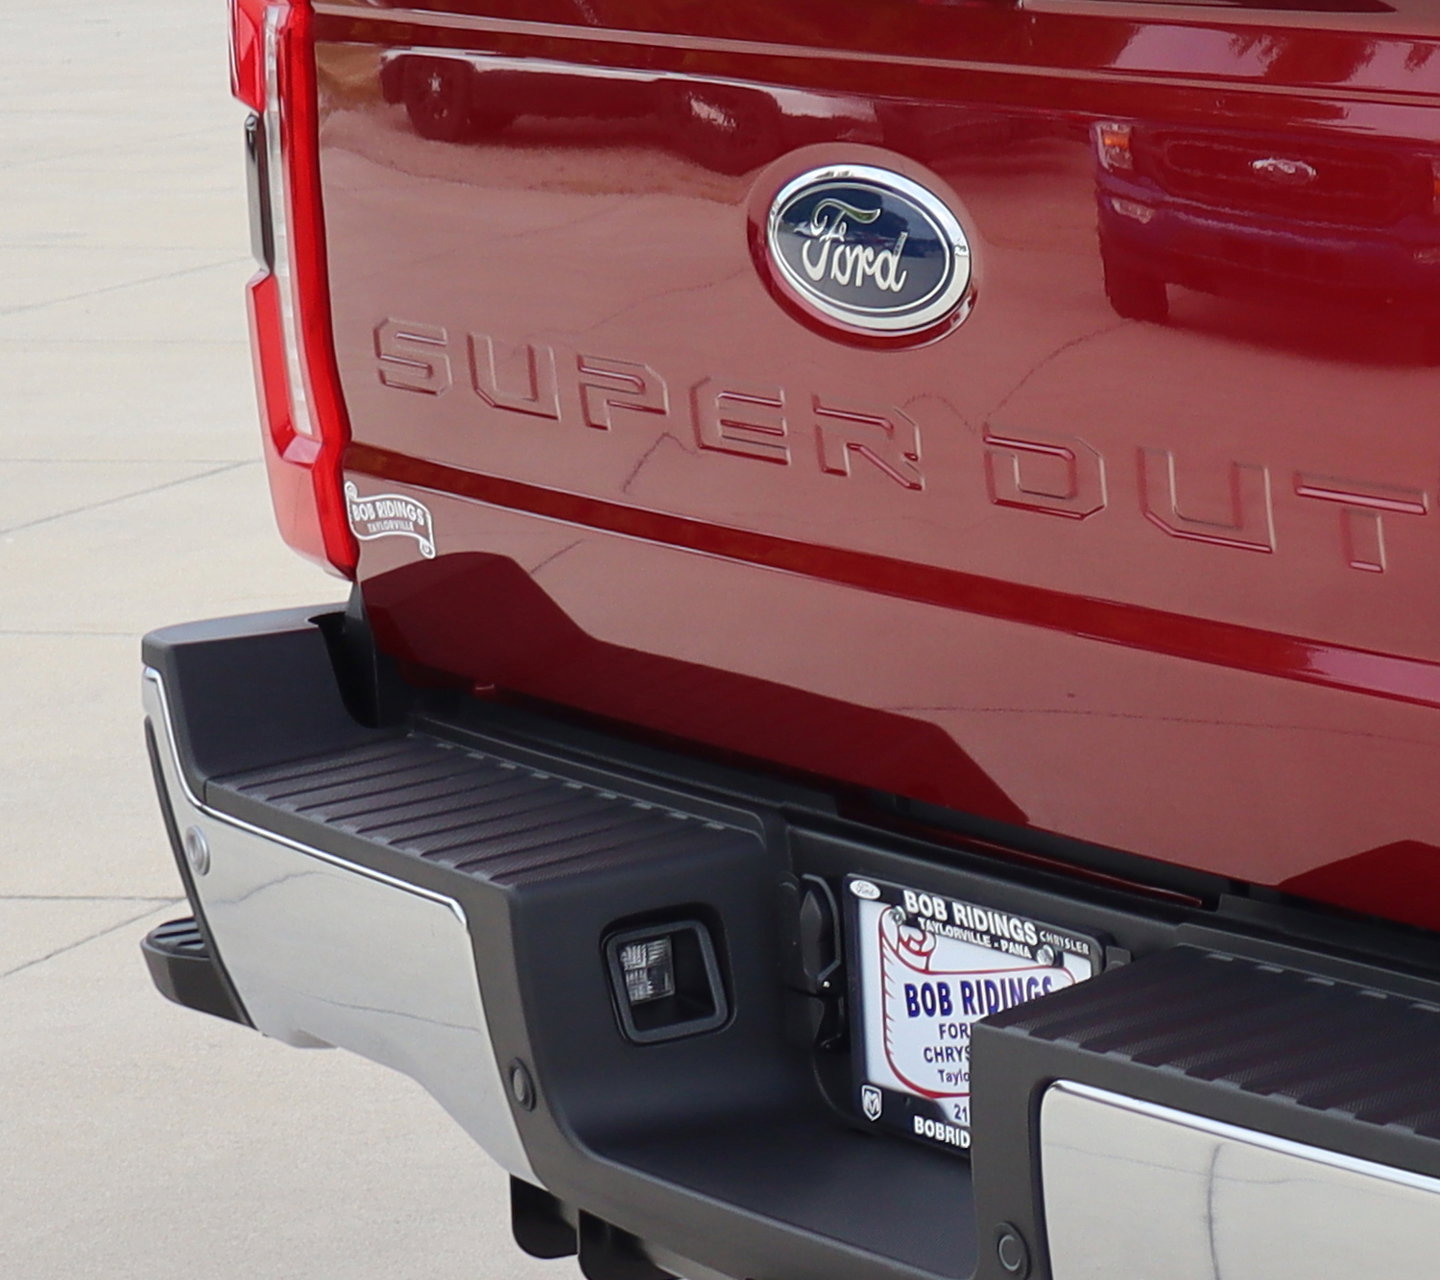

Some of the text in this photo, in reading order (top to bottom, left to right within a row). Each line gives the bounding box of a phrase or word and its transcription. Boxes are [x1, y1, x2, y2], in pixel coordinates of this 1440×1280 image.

[793, 198, 909, 293] Ford
[371, 317, 923, 493] SUPER
[352, 500, 424, 526] BOB RIDINGS
[367, 520, 414, 533] TAYLORVILLE
[903, 889, 1038, 946] BOB RIDINGS
[918, 918, 992, 948] TAYLORVILLE
[1000, 939, 1033, 959] PANA
[1039, 930, 1091, 956] CHRYSLER
[904, 981, 953, 1019] BOB
[938, 1022, 971, 1040] FOR
